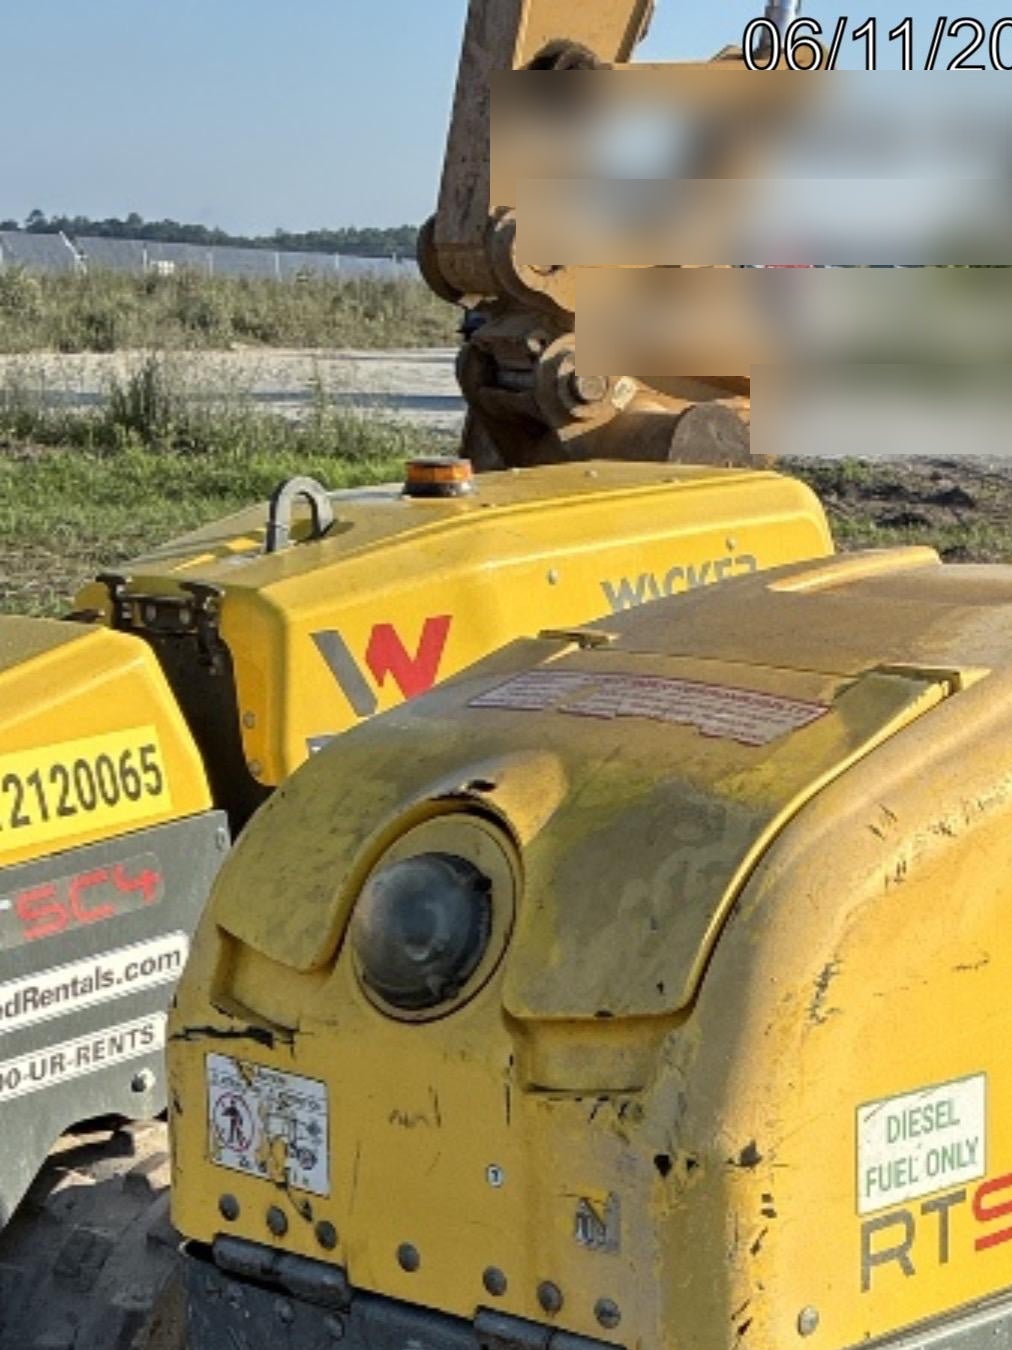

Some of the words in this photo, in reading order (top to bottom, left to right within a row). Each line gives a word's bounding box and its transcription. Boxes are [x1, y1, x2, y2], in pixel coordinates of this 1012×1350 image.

[0, 743, 162, 831] 2120065
[0, 863, 162, 942] SC4
[0, 950, 181, 1020] dRentals.com
[0, 1024, 154, 1093] 0-UR-RENTS
[886, 1098, 961, 1144] DIESEL
[866, 1155, 919, 1198] FUEL
[926, 1136, 979, 1179] ONLY
